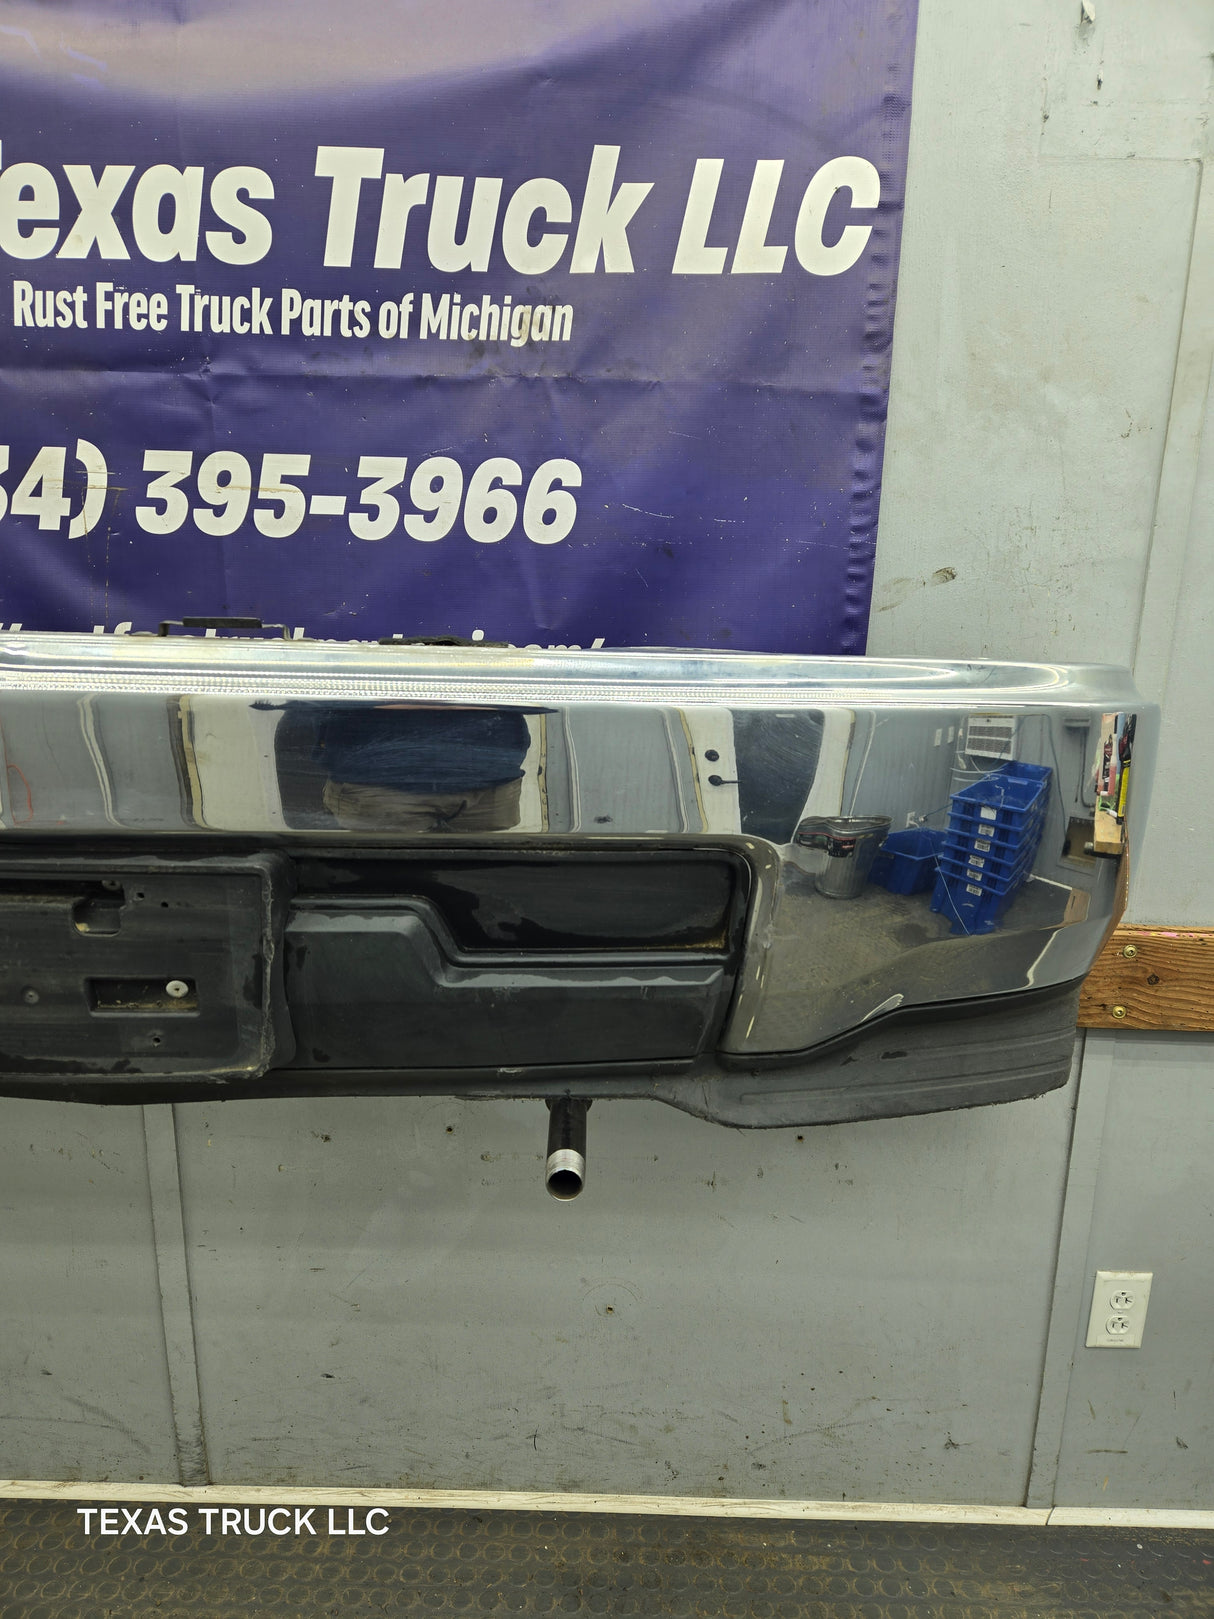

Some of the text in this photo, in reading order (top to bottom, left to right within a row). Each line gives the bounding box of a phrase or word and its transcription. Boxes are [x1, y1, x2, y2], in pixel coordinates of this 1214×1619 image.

[0, 139, 881, 277] exas Truck LLC
[13, 280, 574, 348] Rust Free Truck Parts of Michigan
[0, 438, 583, 545] 4) 395-3966
